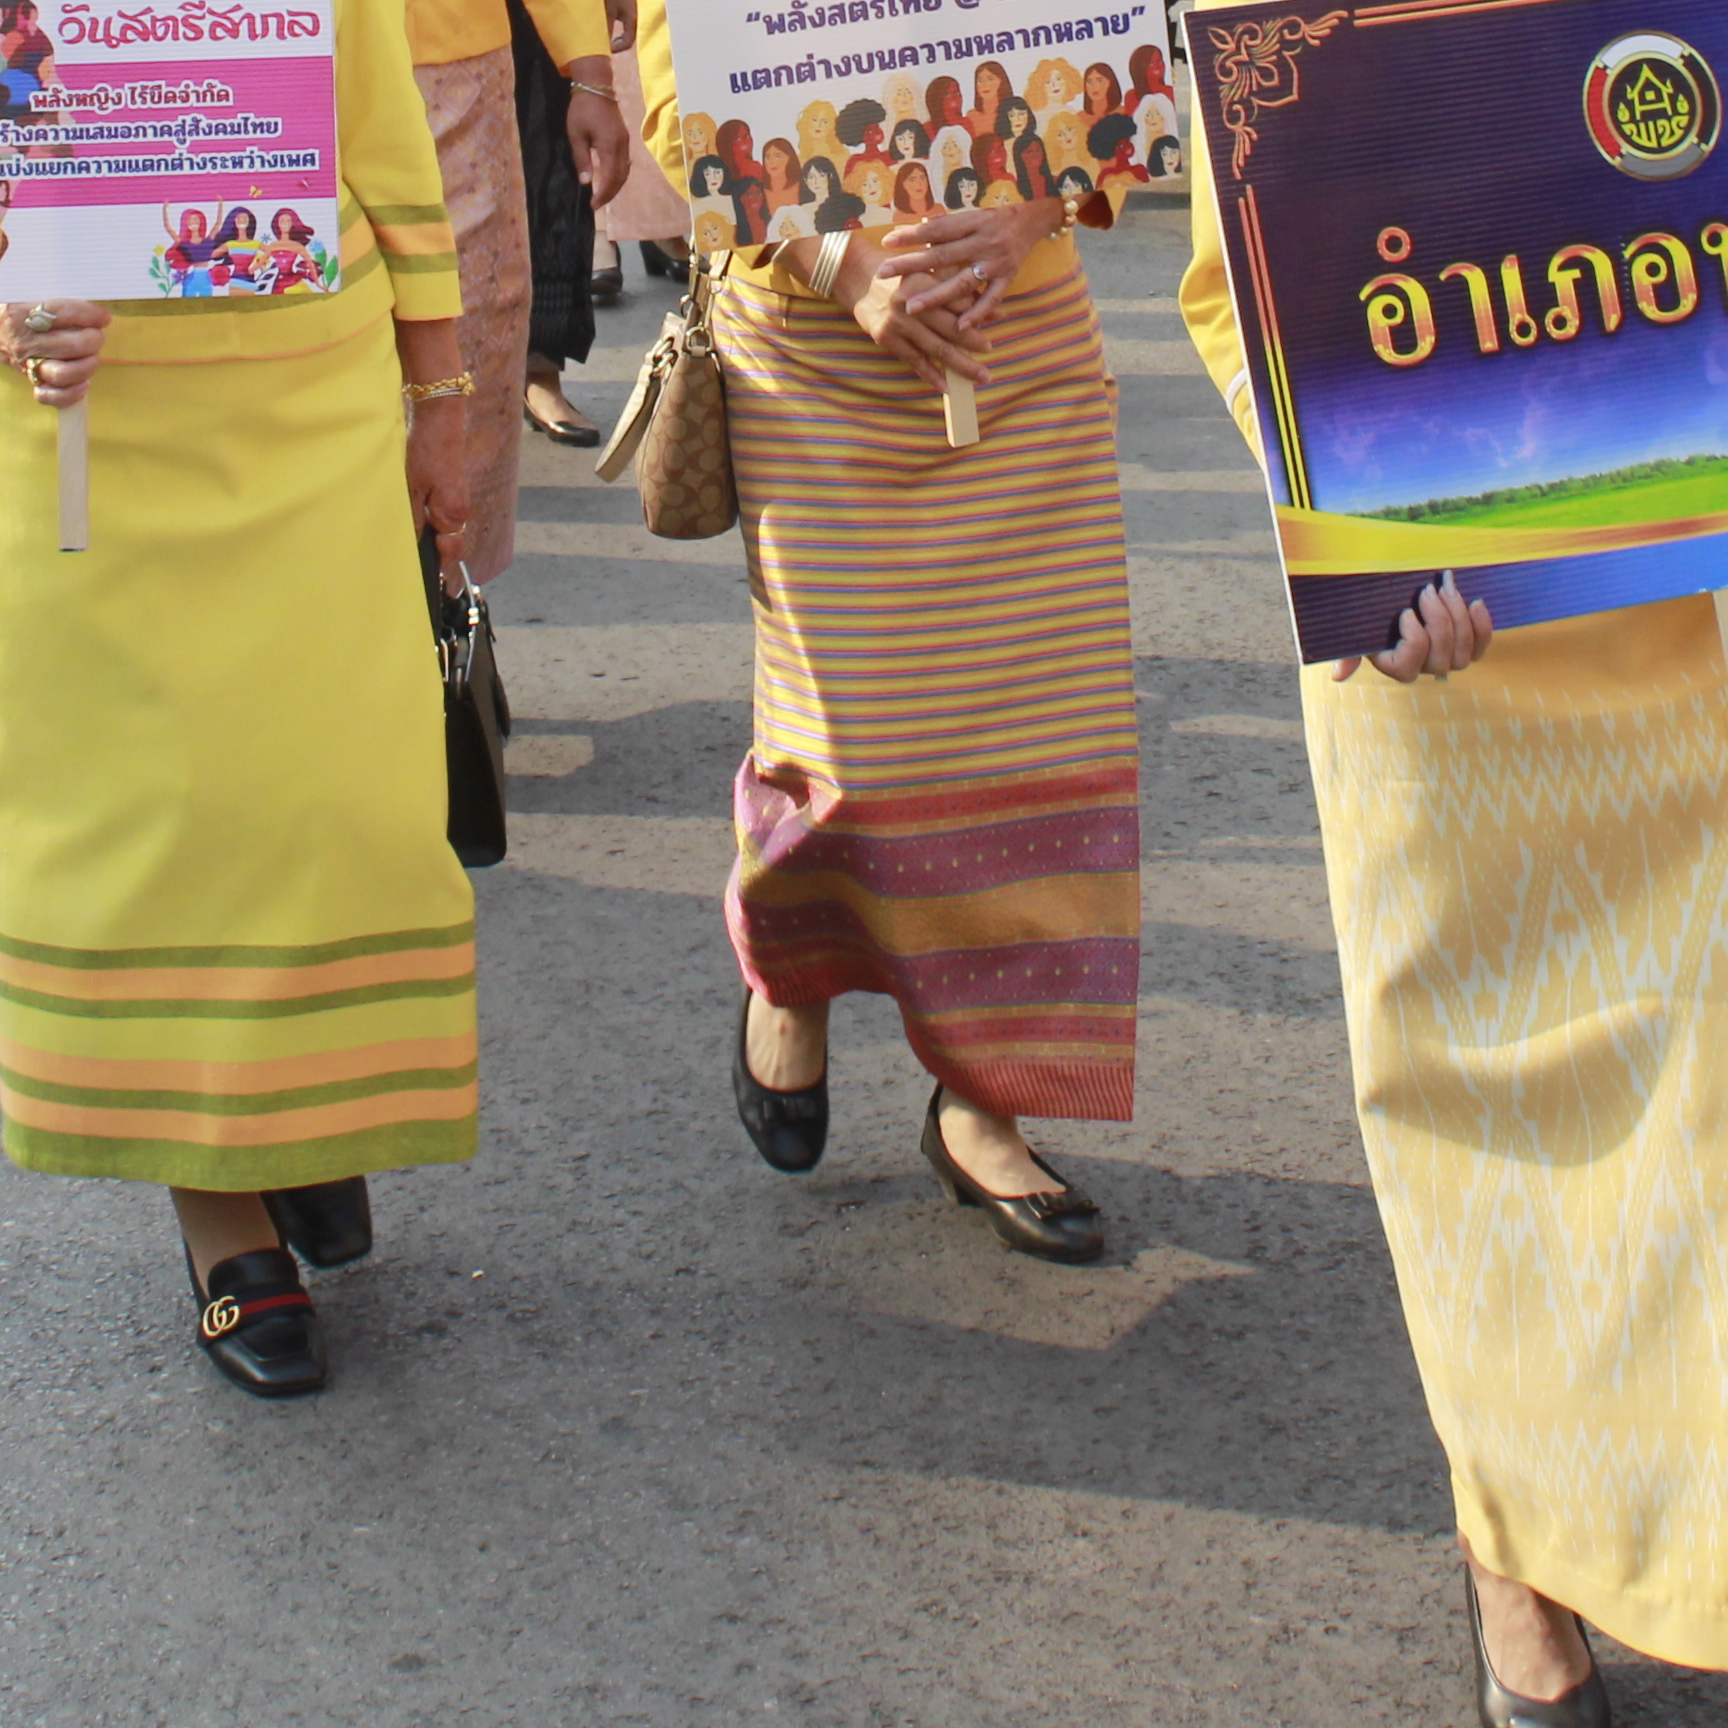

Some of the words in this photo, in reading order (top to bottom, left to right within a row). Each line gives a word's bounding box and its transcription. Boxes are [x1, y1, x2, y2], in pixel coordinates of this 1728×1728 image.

[58, 0, 321, 49] วันสตรีสากล
[729, 6, 1147, 95] แตกต่างบนความหลากหลาย”
[32, 84, 122, 113] พลังหญิง
[128, 80, 231, 108] ไร้ขีดจำกัด
